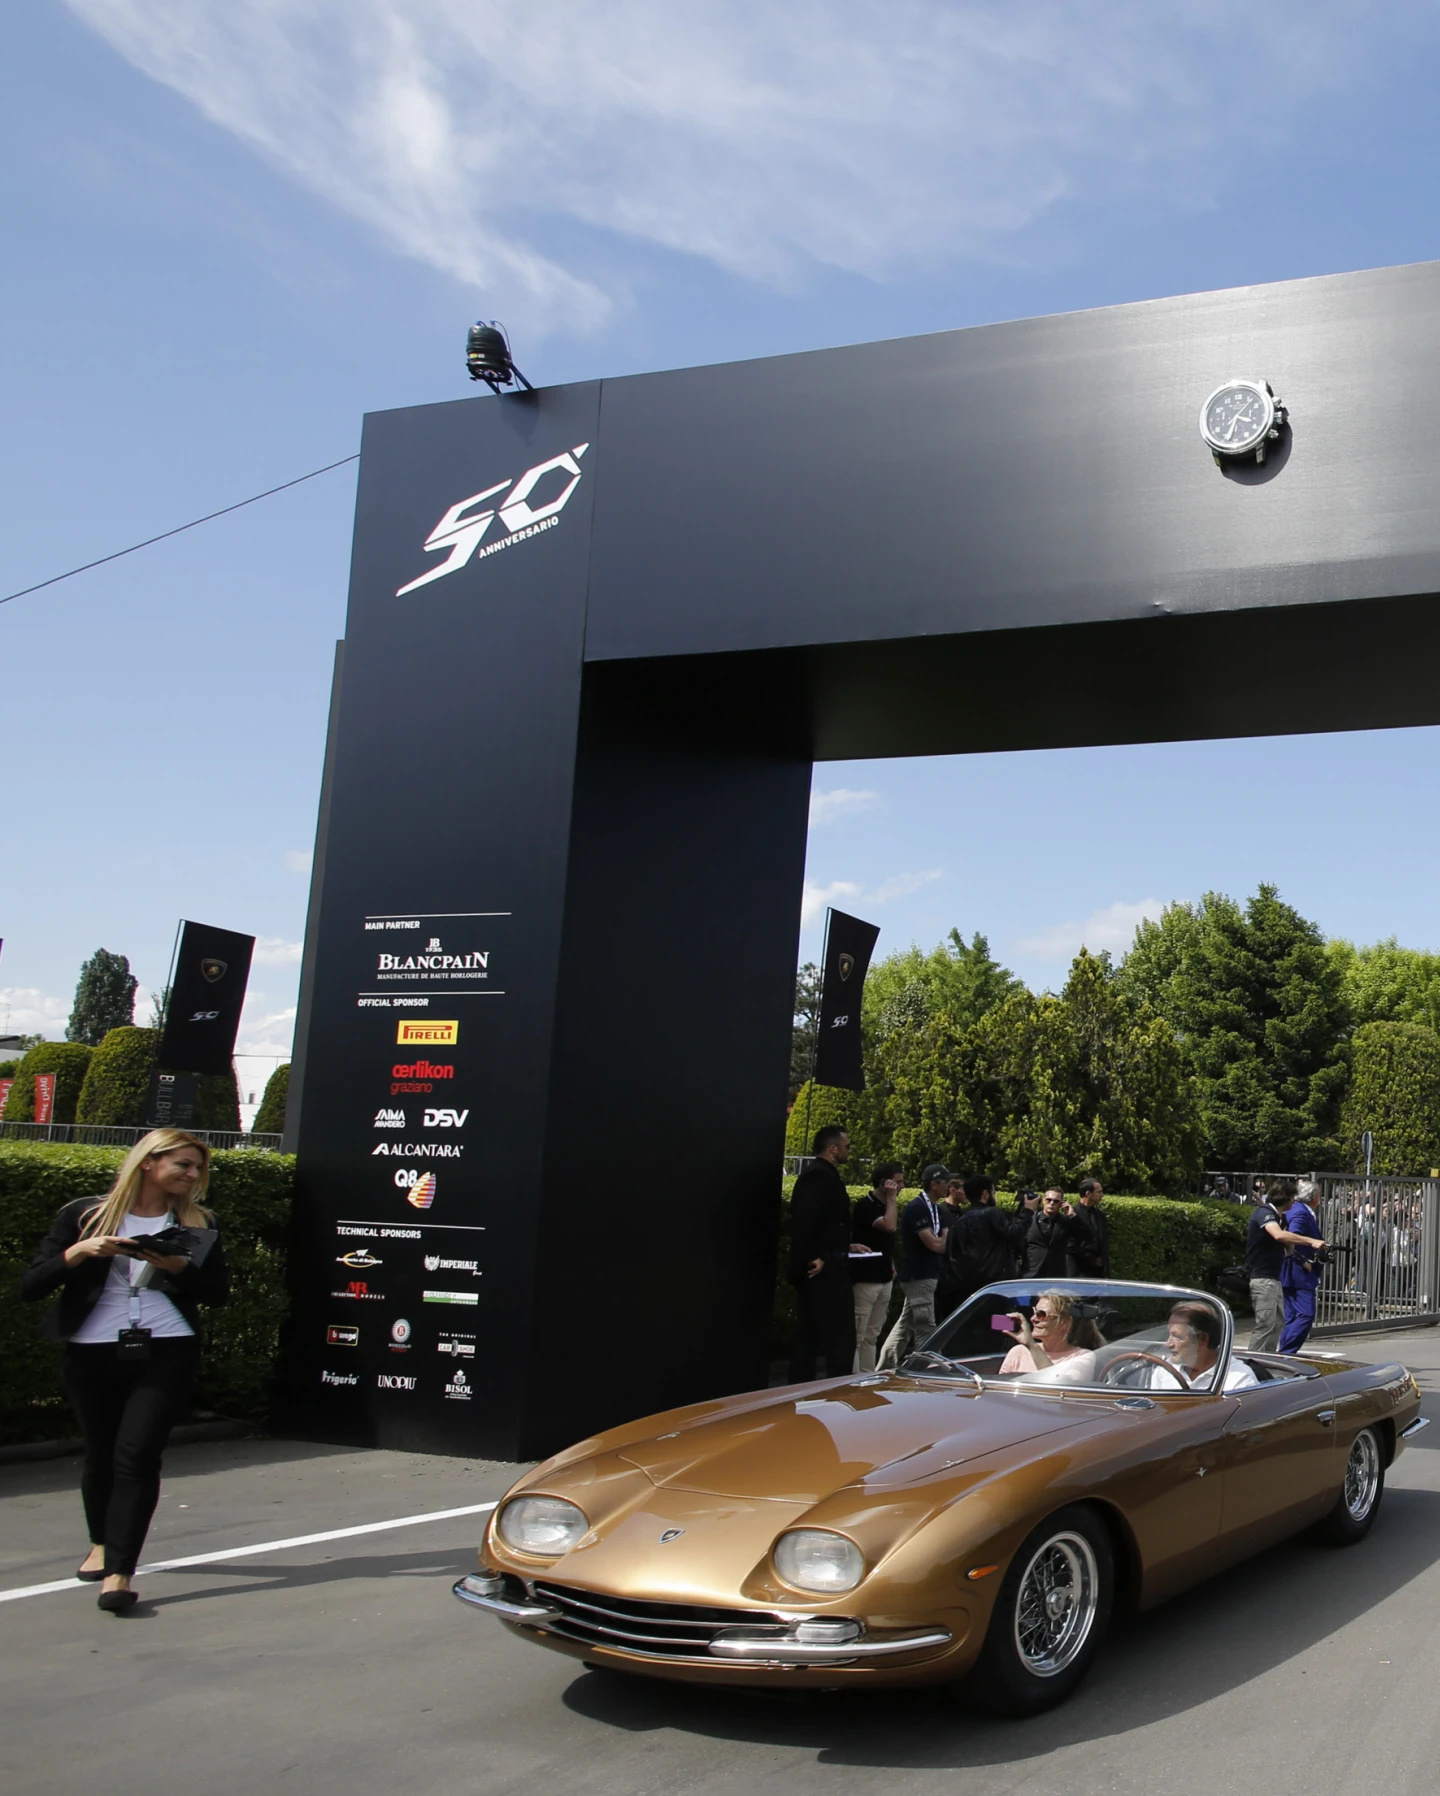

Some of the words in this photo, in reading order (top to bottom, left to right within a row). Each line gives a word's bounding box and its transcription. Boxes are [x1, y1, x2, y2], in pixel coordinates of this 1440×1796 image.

[479, 515, 559, 559] ANNIVERSARIO
[365, 922, 384, 930] MAIN
[386, 921, 420, 929] PARTNER
[378, 952, 490, 970] BLANCPAIN
[358, 999, 391, 1007] OFFICIAL
[393, 999, 429, 1007] SPONSOR
[403, 1025, 453, 1040] PIRELLI
[390, 1081, 433, 1095] graziano
[423, 1109, 469, 1127] DSV
[394, 1169, 418, 1188] Q8
[336, 1227, 379, 1237] TECHNICAL
[380, 1229, 422, 1239] SPONSORS
[440, 1259, 478, 1270] IMPERIALE
[322, 1370, 357, 1385] Frigerio
[445, 1384, 473, 1394] BISOL
